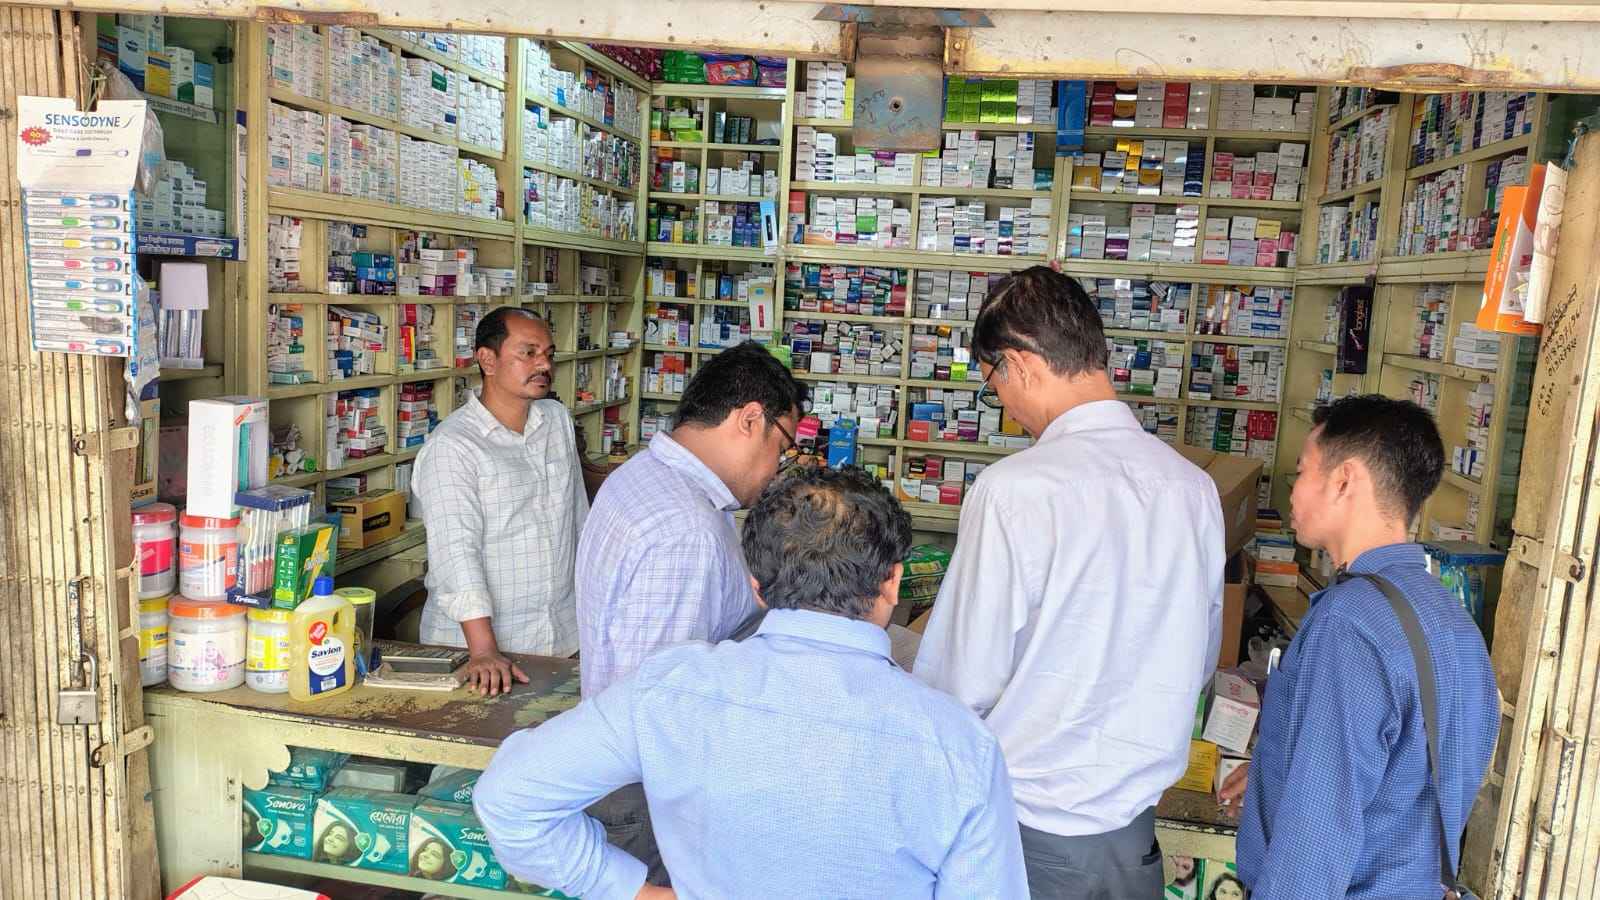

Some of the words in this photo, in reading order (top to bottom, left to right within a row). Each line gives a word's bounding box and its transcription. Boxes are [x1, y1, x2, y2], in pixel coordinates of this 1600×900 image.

[45, 113, 121, 128] SENSODYNE
[311, 646, 342, 658] Savlon
[459, 827, 488, 842] Seno
